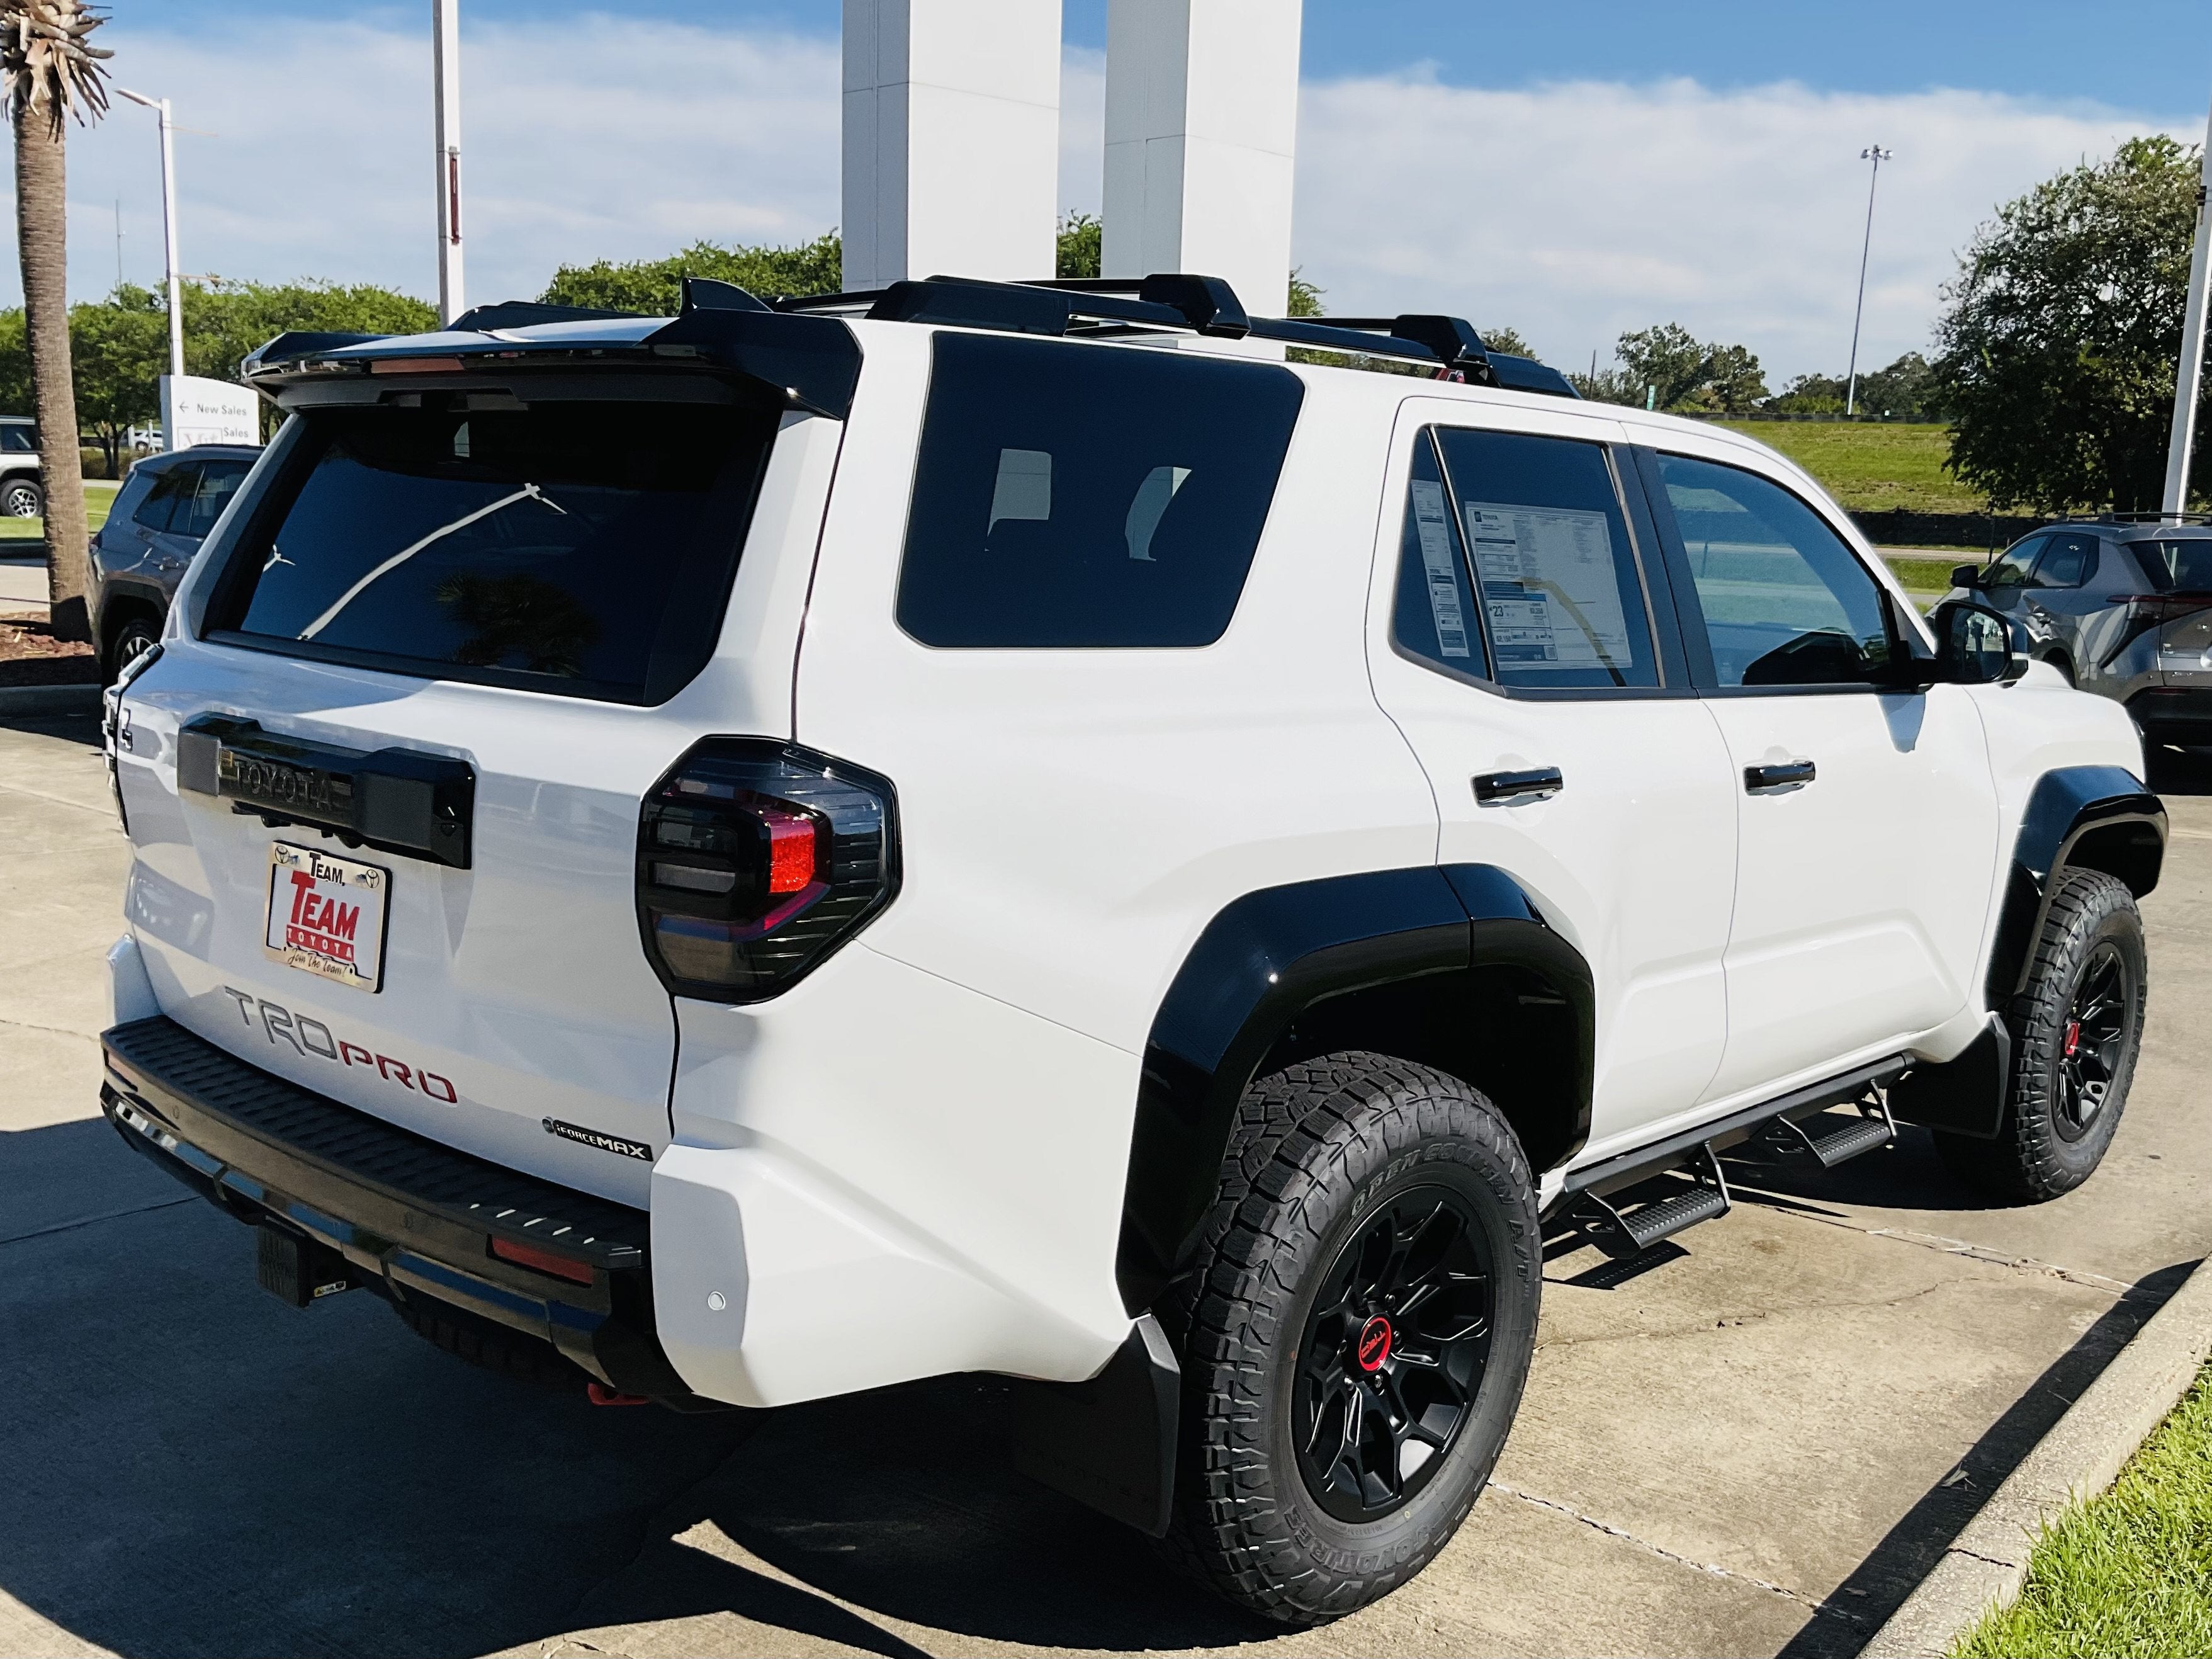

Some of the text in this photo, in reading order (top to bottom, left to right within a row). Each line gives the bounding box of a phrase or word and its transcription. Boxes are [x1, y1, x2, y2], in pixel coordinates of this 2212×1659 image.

[196, 404, 247, 416] New Sales
[223, 427, 249, 438] Sales
[291, 870, 360, 941] TEAM
[287, 927, 353, 959] TOYOTA
[339, 1040, 458, 1103] PRO
